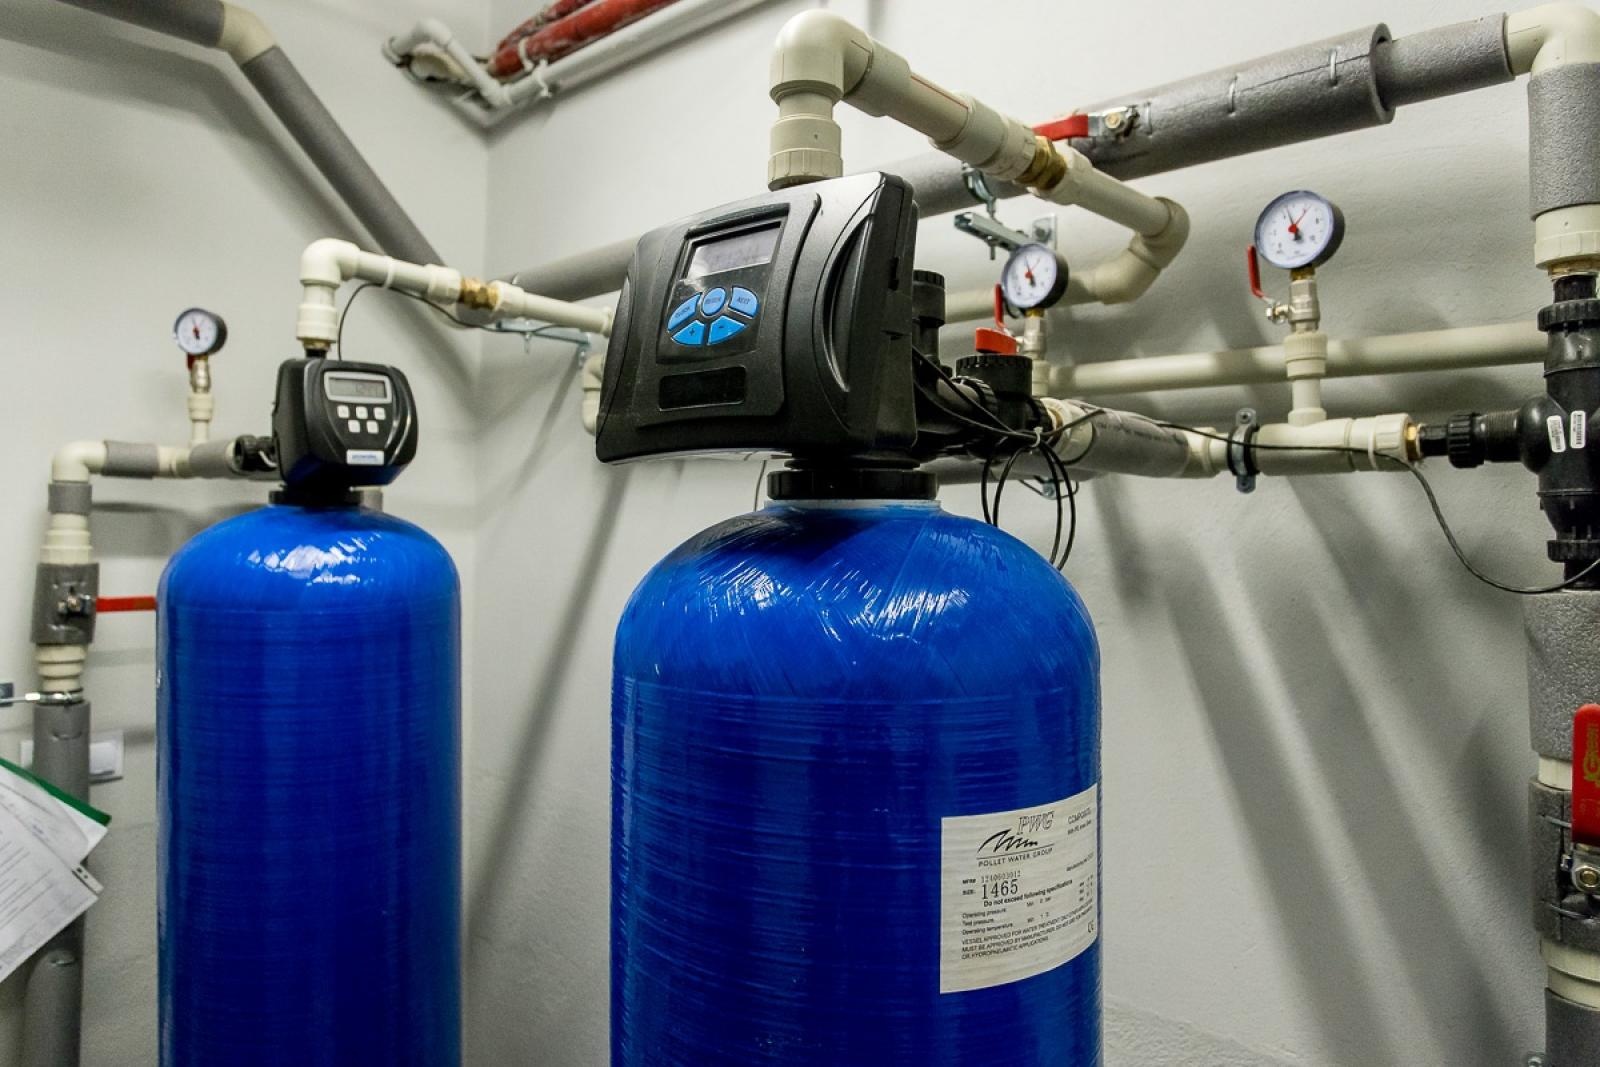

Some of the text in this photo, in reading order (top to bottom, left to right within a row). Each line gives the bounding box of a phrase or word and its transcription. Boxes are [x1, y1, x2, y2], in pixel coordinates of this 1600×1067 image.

[1016, 811, 1055, 835] PWG
[978, 847, 1054, 868] POLLET WATER GROUP
[981, 878, 1019, 900] 1465
[993, 898, 1004, 906] not
[1012, 930, 1022, 938] FOR
